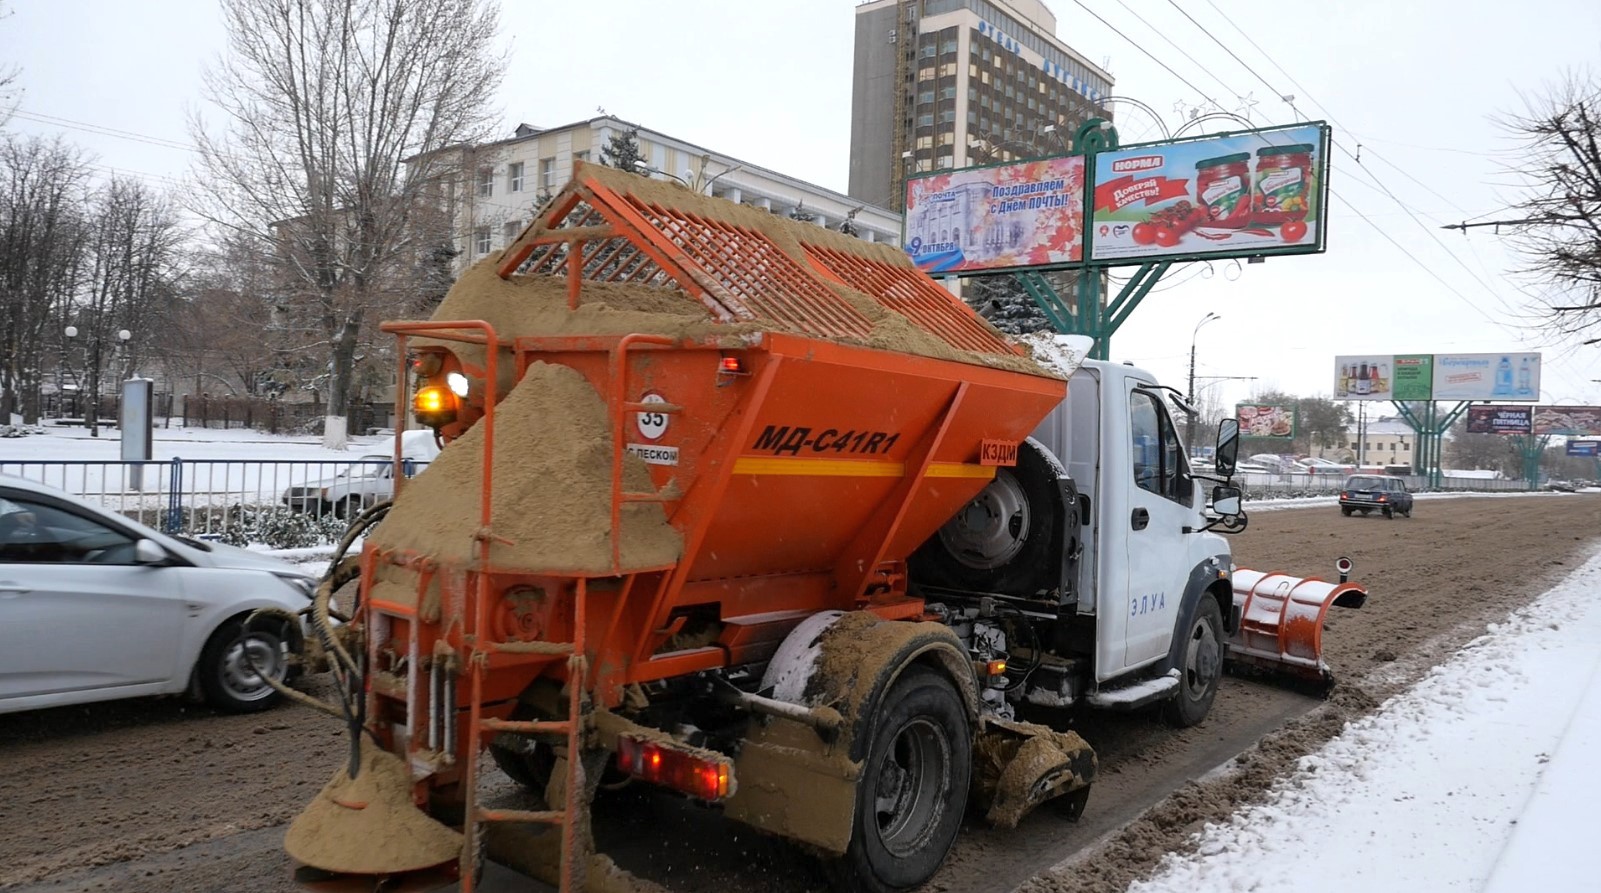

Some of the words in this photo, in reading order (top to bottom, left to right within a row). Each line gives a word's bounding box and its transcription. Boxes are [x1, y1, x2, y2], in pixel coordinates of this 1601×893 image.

[978, 20, 1021, 55] ОТЕЛЬ
[1114, 157, 1161, 171] НОРМА
[933, 191, 955, 199] ПОЧТА
[992, 179, 1065, 198] Поздравляем
[990, 203, 996, 214] с
[998, 201, 1026, 215] Днем
[1028, 194, 1069, 209] ПОЧТЫ!
[911, 236, 922, 254] 9
[923, 242, 954, 253] ОКТЯБРЯ
[642, 412, 664, 427] 35
[1131, 592, 1165, 617] ЭЛУА
